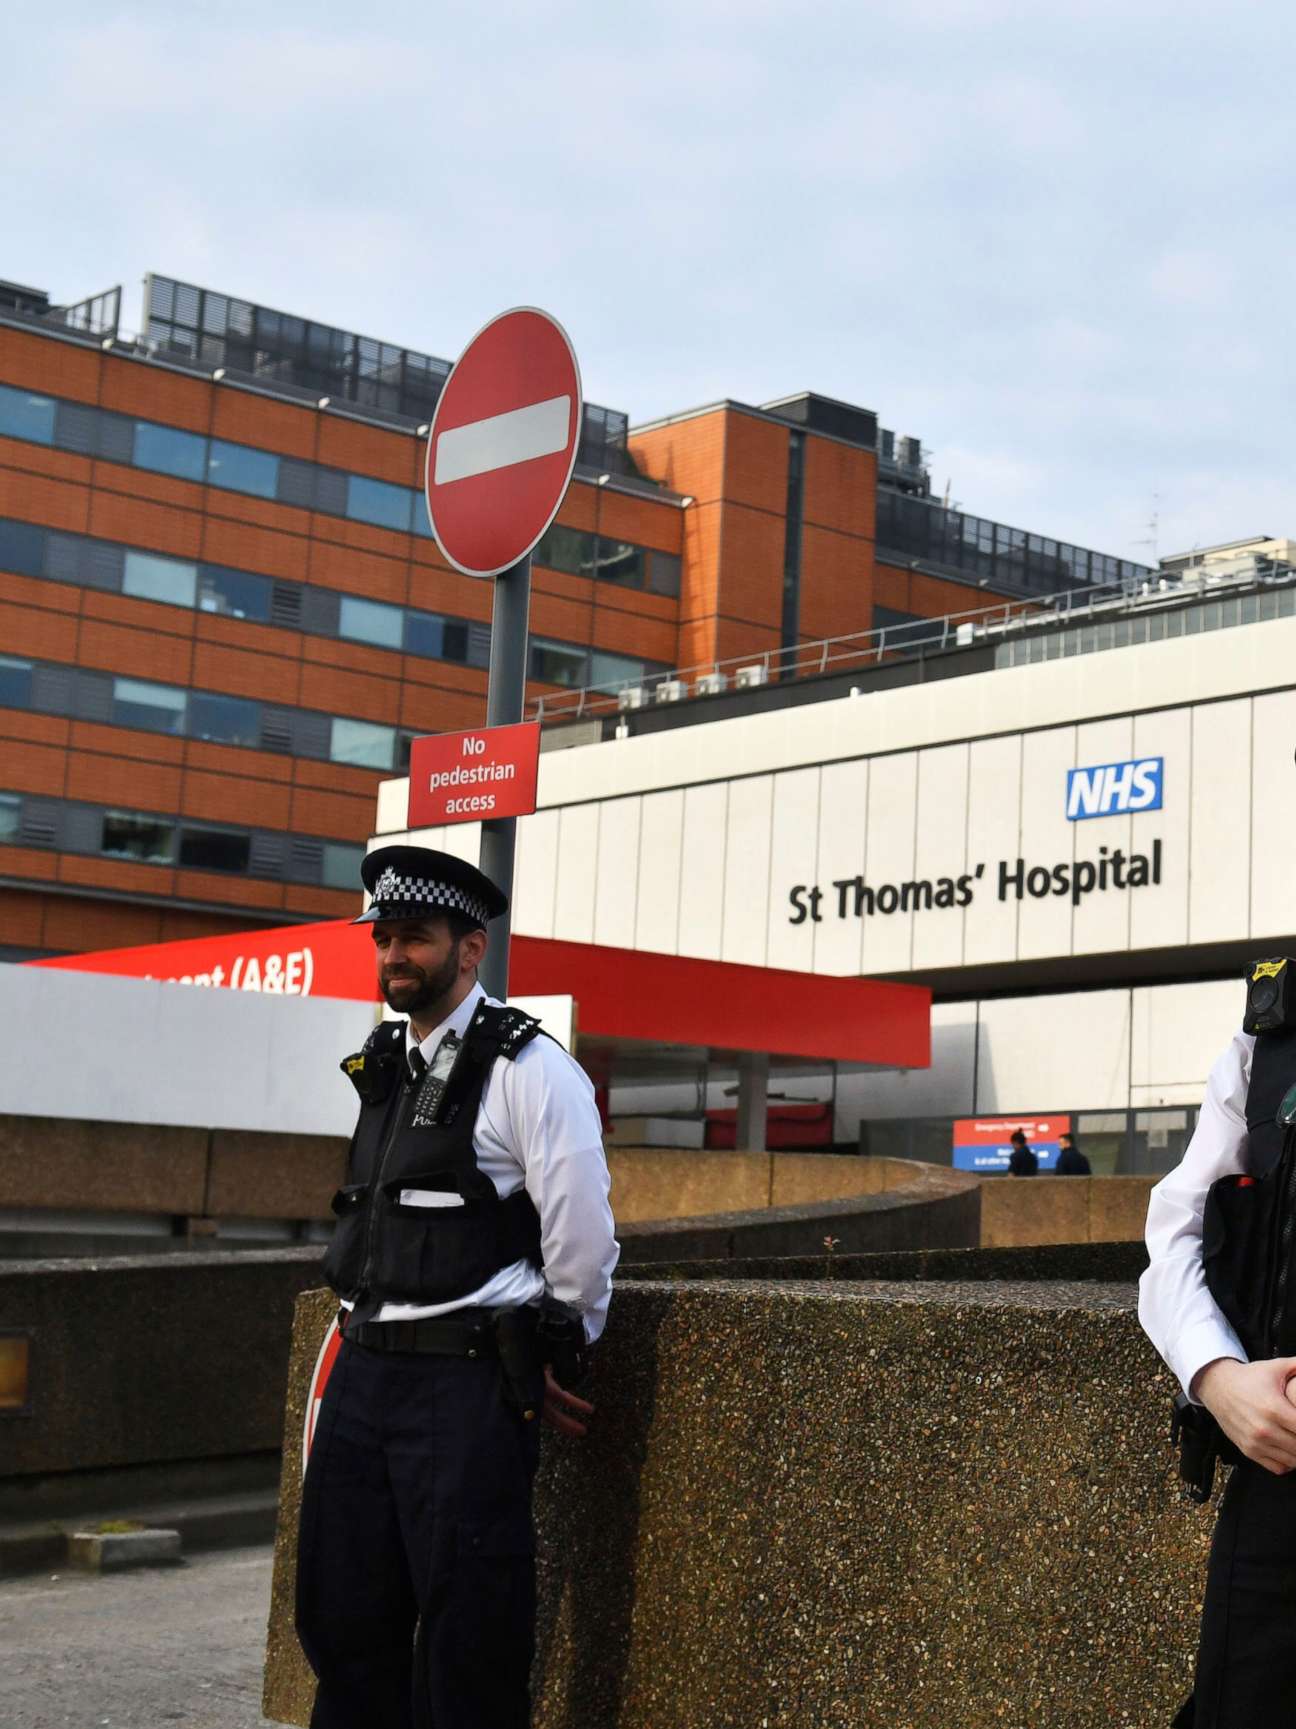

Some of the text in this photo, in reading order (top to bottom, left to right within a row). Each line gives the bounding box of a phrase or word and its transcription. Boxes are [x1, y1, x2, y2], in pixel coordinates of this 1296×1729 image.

[462, 736, 486, 756] No
[429, 760, 516, 794] pedestrian
[1066, 760, 1160, 817] NHS
[445, 794, 496, 814] access
[788, 838, 1163, 925] St Thomas' Hospital
[229, 946, 315, 998] (A&E)
